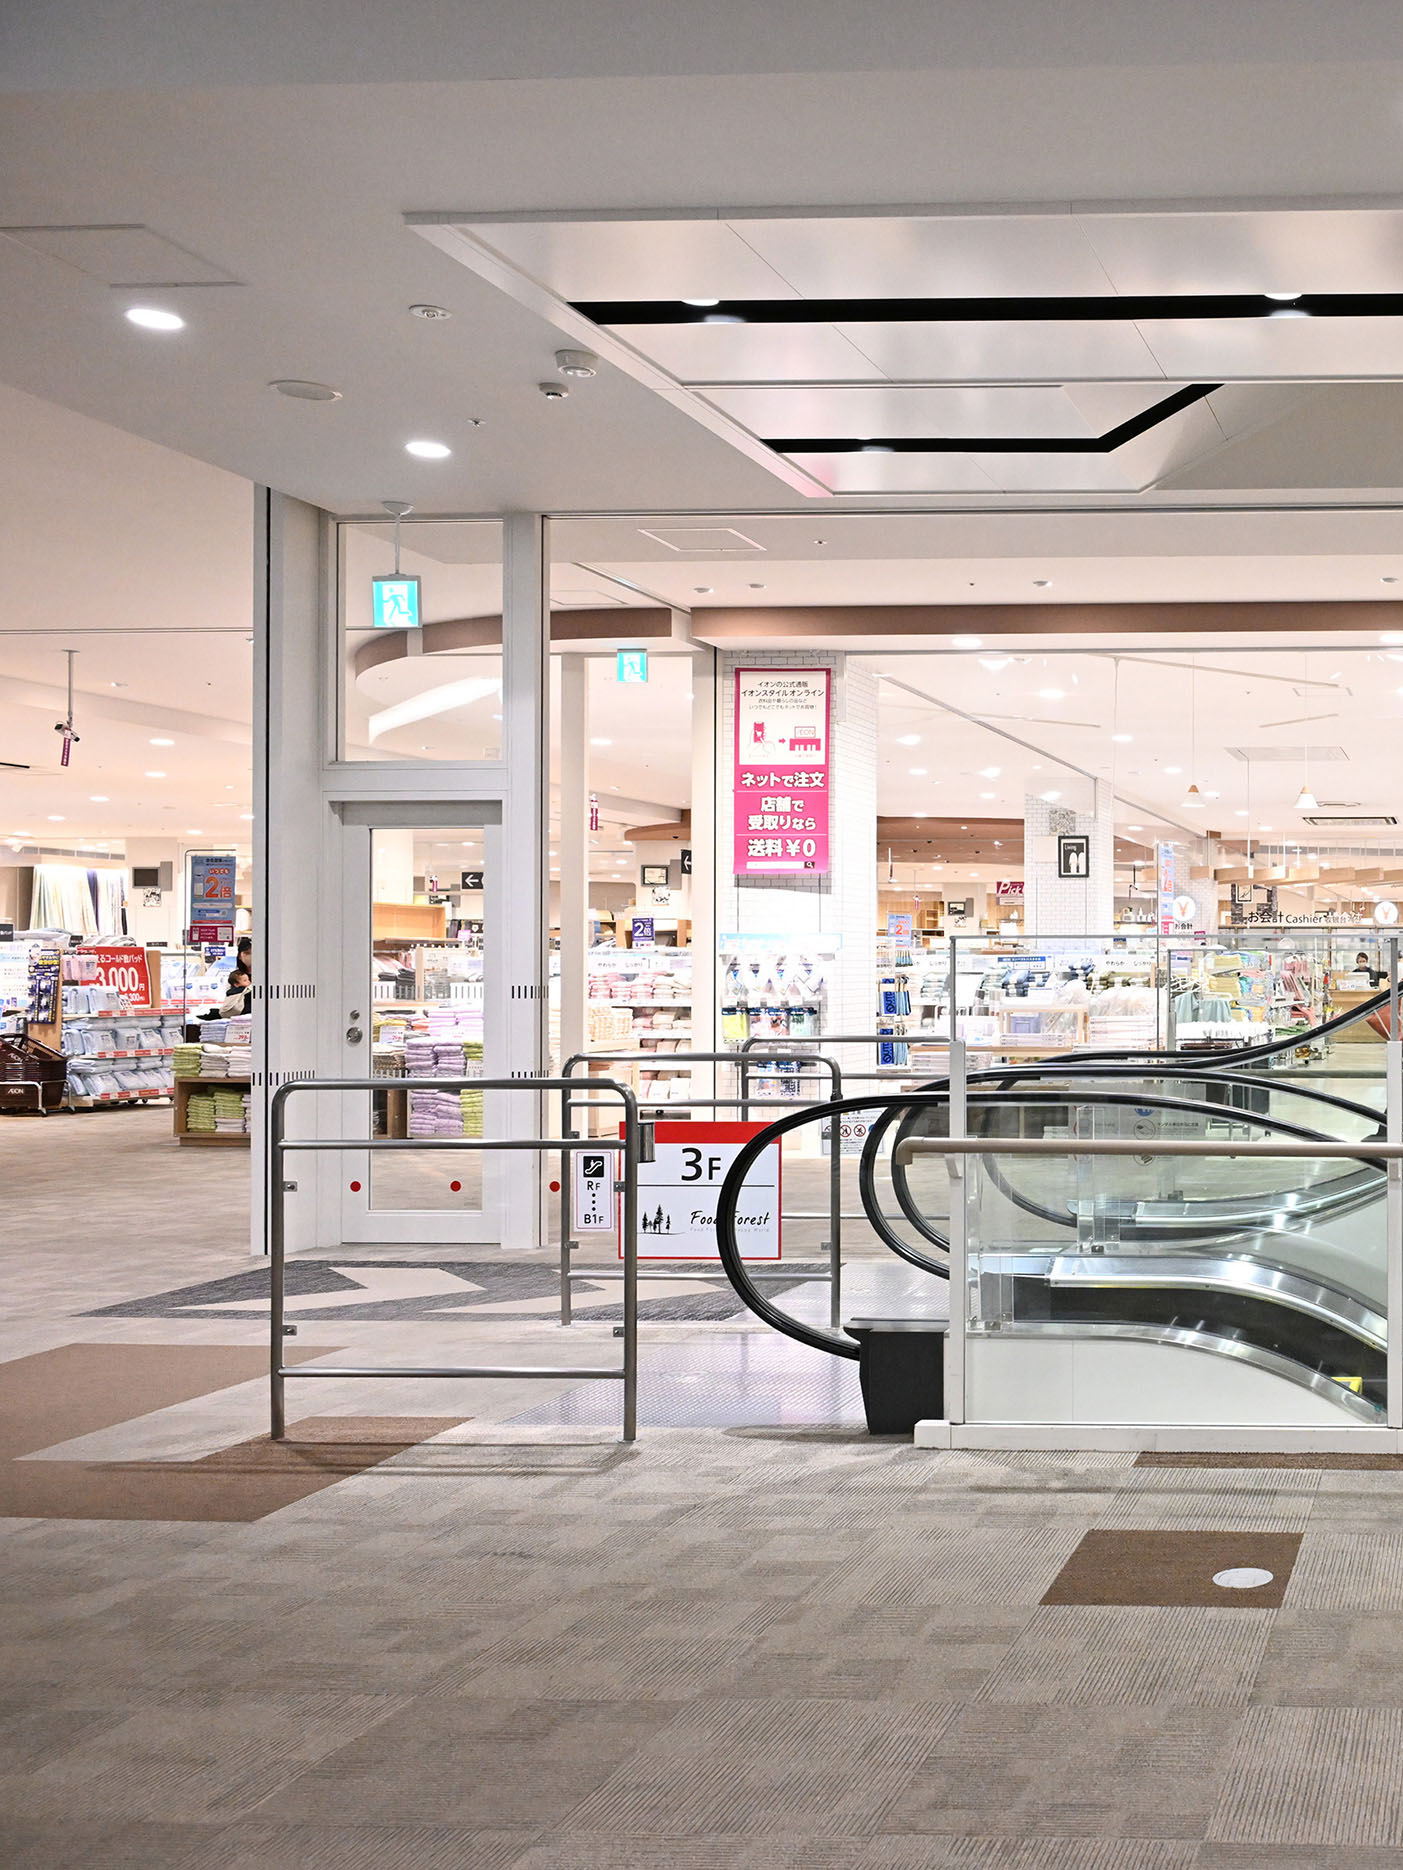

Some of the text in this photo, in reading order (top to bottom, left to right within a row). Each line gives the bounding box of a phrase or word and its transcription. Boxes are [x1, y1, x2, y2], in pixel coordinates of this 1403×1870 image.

[741, 689, 824, 697] イオンスタイルオンライン
[741, 771, 825, 787] ネットで注文
[761, 796, 804, 812] 店舗で
[748, 814, 816, 830] 受取りなら
[1286, 914, 1322, 923] Cashier
[680, 1147, 722, 1181] 3F
[586, 1180, 601, 1191] RF
[583, 1213, 604, 1225] B1F
